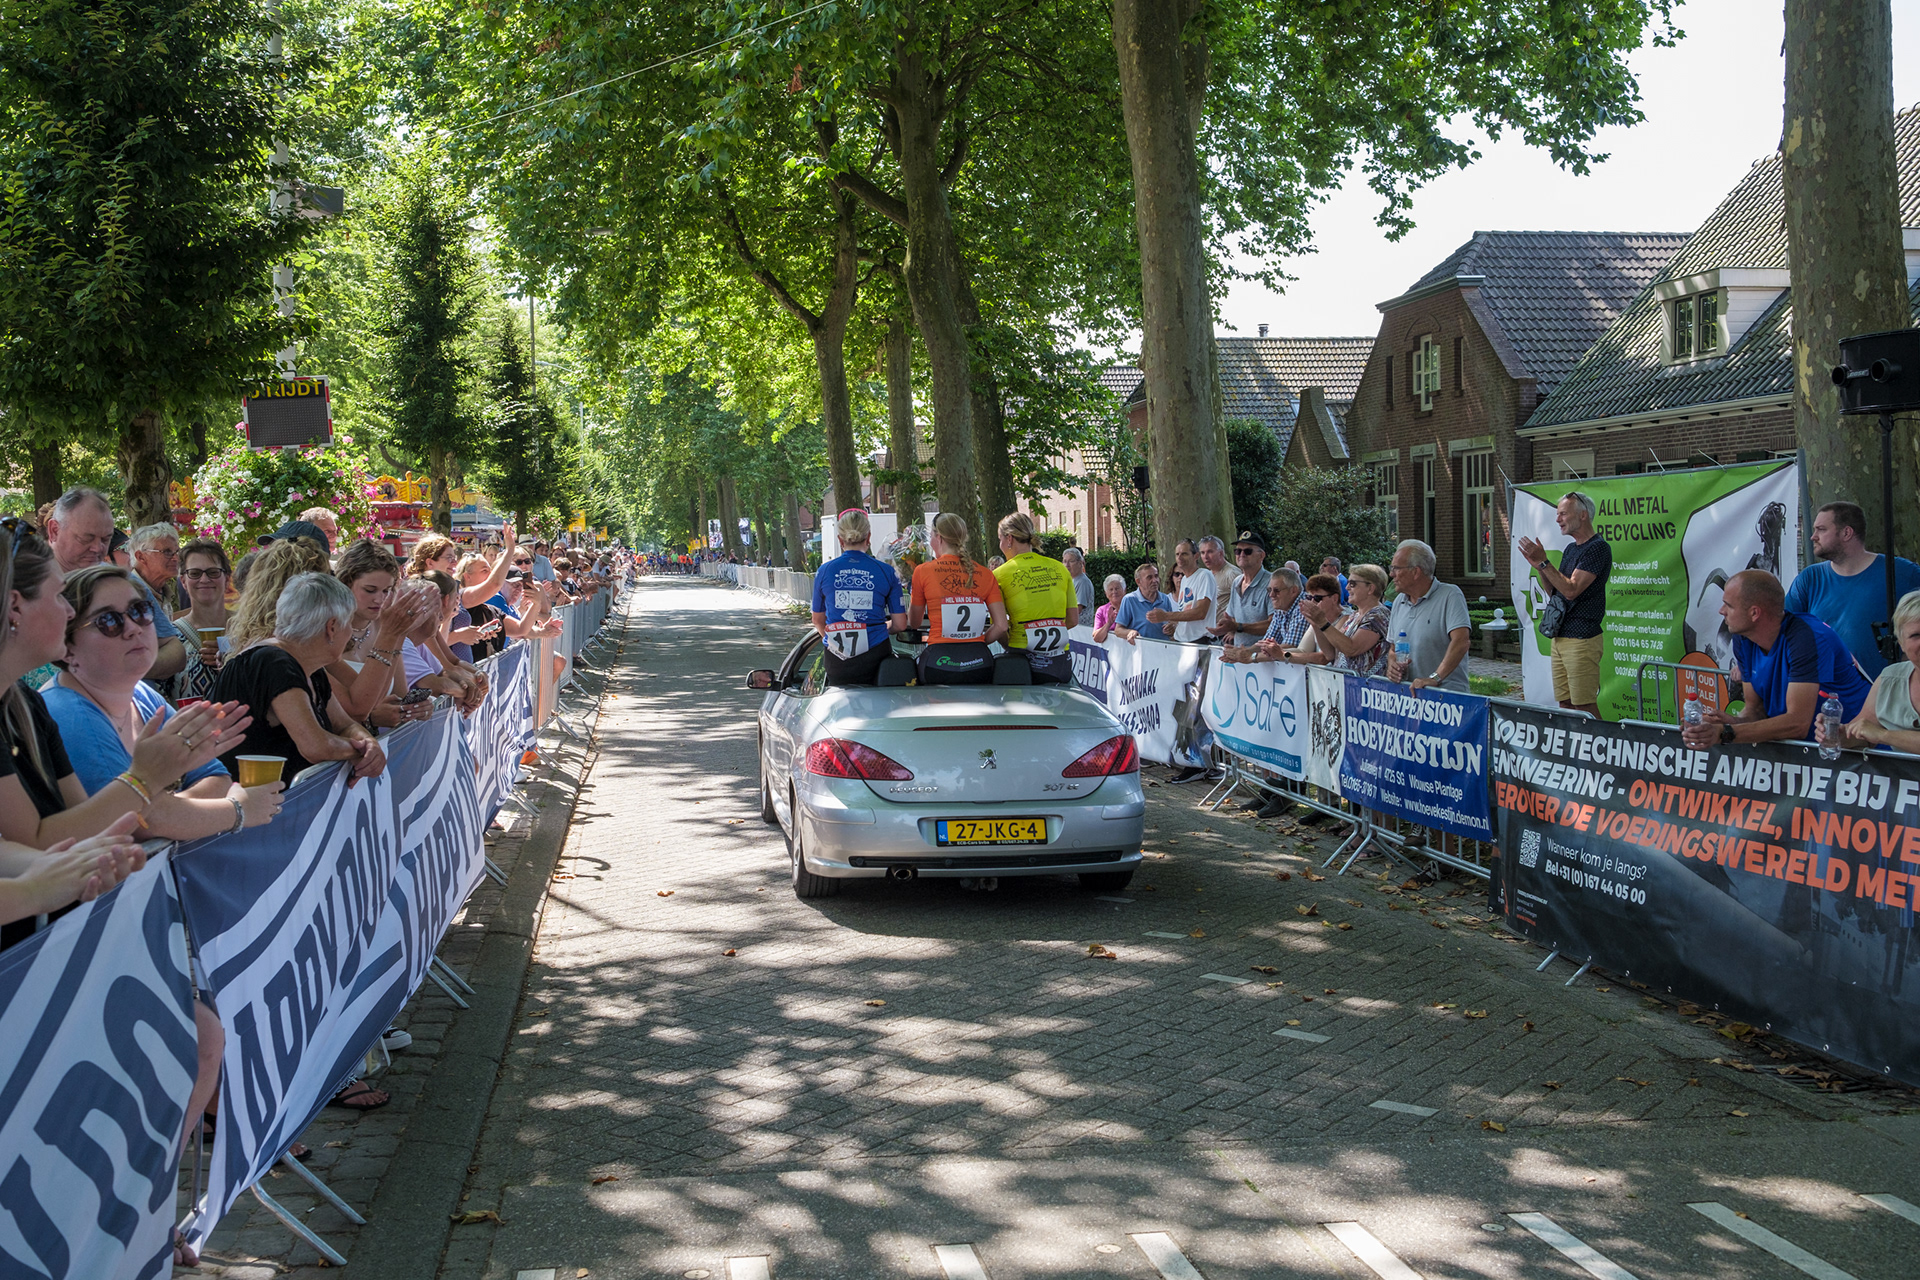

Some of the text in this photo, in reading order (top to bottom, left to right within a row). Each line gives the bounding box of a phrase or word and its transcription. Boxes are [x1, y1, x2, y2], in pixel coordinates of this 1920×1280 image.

[1598, 496, 1669, 516] ALL METAL
[1597, 522, 1676, 541] RECYCLING
[1632, 588, 1665, 596] Noordstraat
[956, 605, 971, 632] 2
[1605, 609, 1674, 620] www.amr-metalen.nl
[1033, 627, 1061, 652] 22
[1606, 622, 1672, 635] info@amr-metalen.nl
[833, 631, 859, 656] 17
[1613, 637, 1628, 647] 0031
[1628, 638, 1640, 648] 164
[1640, 640, 1650, 649] 65
[1070, 648, 1108, 692] elen
[1613, 652, 1628, 661] 0031
[1629, 653, 1640, 663] 164
[1698, 676, 1716, 687] OUD
[1244, 671, 1296, 738] SaFe
[1361, 687, 1464, 727] DIERENPENSION
[1346, 716, 1483, 776] HOEVEKESTIJN
[1540, 727, 1567, 757] JE
[1569, 731, 1710, 782] TECHNISCHE
[1711, 754, 1832, 801] AMBITIE
[1835, 770, 1891, 811] BIJ
[1894, 778, 1920, 814] F
[1380, 787, 1402, 808] Website:
[1396, 771, 1406, 787] SG
[1408, 774, 1434, 793] Wouwse
[1434, 780, 1463, 802] Plantage
[1492, 748, 1615, 800] ENGINEERING
[1628, 779, 1784, 841] ONTWIKKEL,
[955, 822, 1038, 840] 27-JKG-4
[1495, 780, 1920, 913] EROVER DE VOEDINGSWERELD MET
[1546, 837, 1648, 881] Wanneer kom je langs?
[1545, 859, 1559, 877] Bel
[1571, 868, 1584, 888] (0)
[1584, 872, 1599, 891] 167
[1600, 878, 1614, 896] 44
[1614, 882, 1629, 900] 05
[1630, 887, 1647, 906] 00
